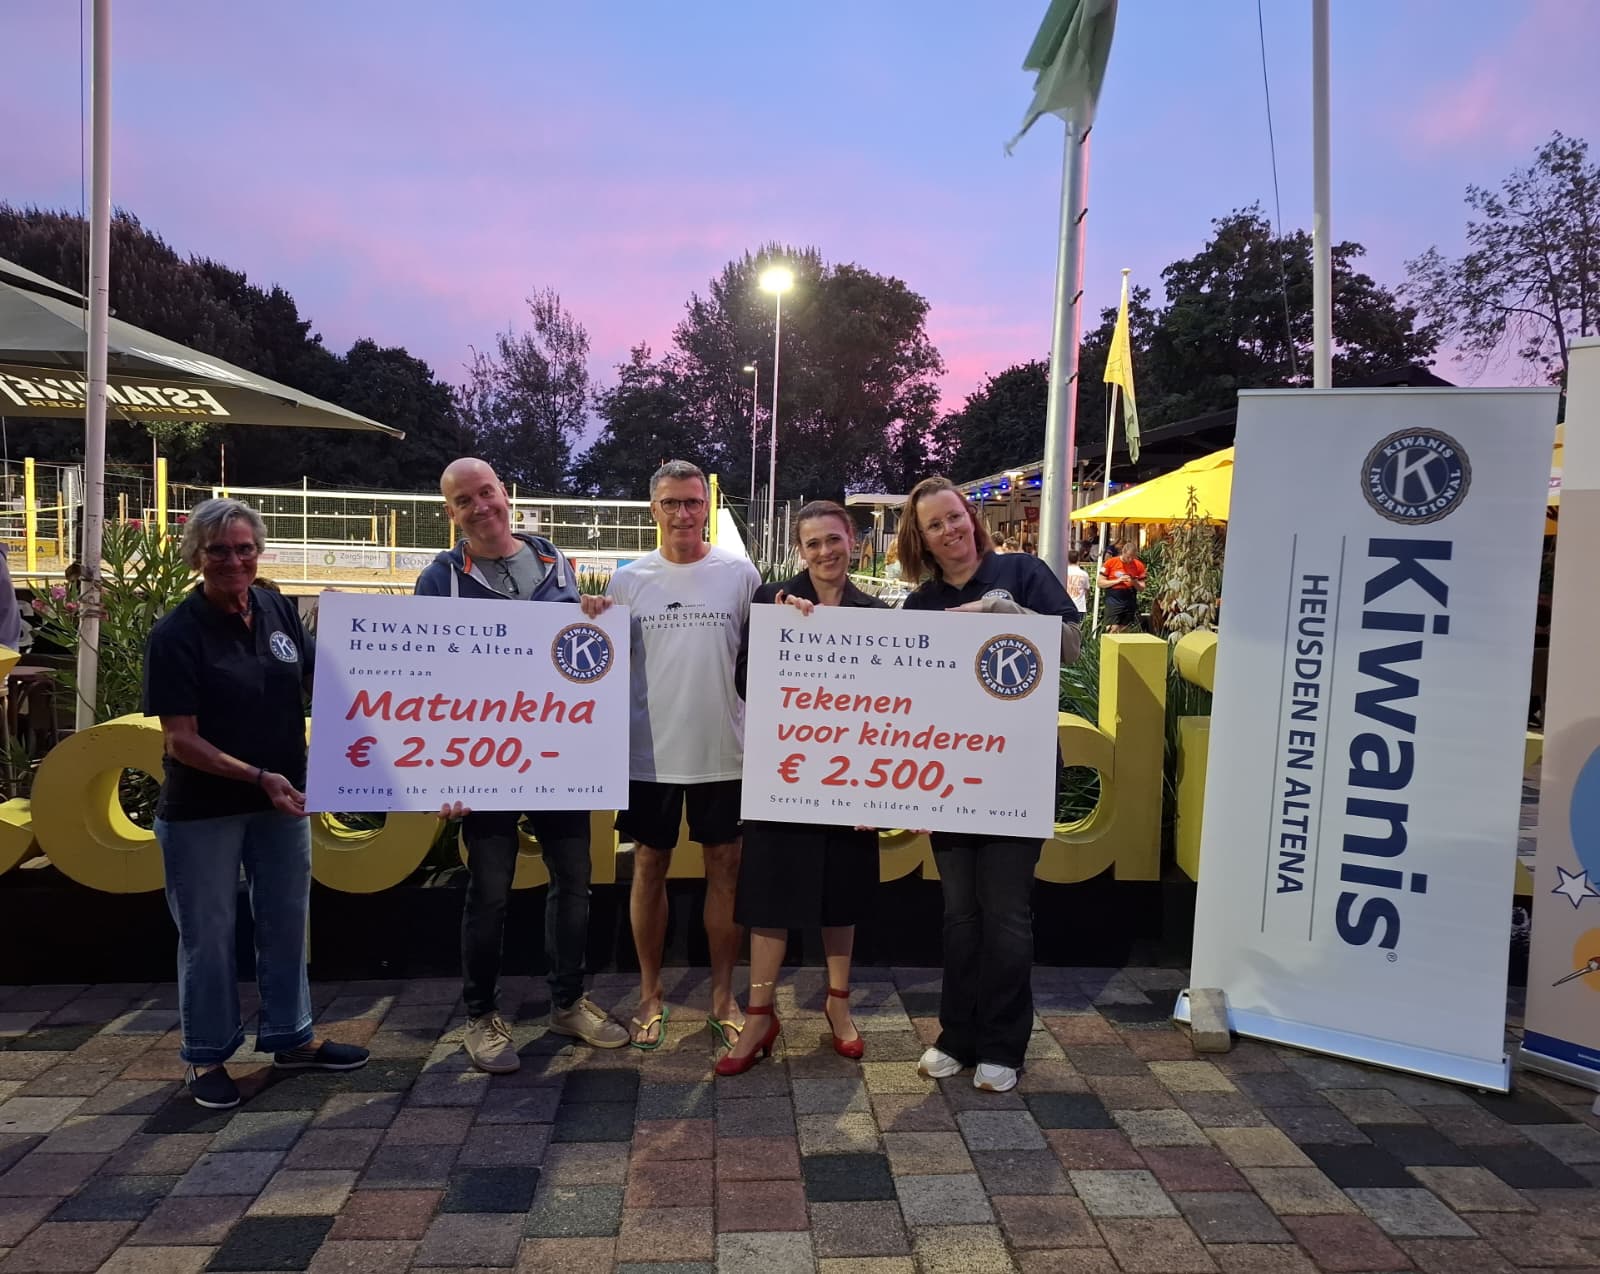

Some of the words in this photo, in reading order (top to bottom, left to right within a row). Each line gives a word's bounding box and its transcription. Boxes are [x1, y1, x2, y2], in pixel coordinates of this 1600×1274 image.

[1383, 436, 1454, 459] KIWANIS
[1370, 467, 1462, 517] INTERNATIONAL
[351, 618, 507, 637] KIWANISCLUB
[659, 613, 679, 621] DER
[682, 612, 732, 621] STRAATEN
[349, 639, 436, 653] Heusden
[447, 642, 460, 653] &
[471, 643, 535, 656] Altena
[563, 627, 603, 643] KIWANIS
[779, 628, 930, 649] KIWANISCLUB
[988, 639, 1032, 656] KIWANIS
[1290, 574, 1330, 721] HEUSDEN
[349, 667, 403, 677] doneert
[555, 647, 608, 680] INTERNATIONAL
[779, 650, 860, 665] Heusden
[870, 653, 882, 666] &
[893, 655, 958, 669] Altena
[779, 669, 828, 680] doneert
[835, 672, 856, 680] aan
[980, 659, 1037, 695] INTERNATIONAL
[345, 689, 596, 725] Matunkha
[780, 686, 912, 715] Tekenen
[777, 722, 849, 744] voor
[858, 722, 1006, 754] kinderen
[1286, 729, 1316, 771] EN
[1335, 537, 1455, 950] Kiwanis
[345, 736, 378, 768] €
[394, 736, 560, 774] 2.500,-
[777, 753, 806, 784] €
[820, 755, 983, 799] 2.500,-
[338, 785, 394, 797] Serving
[406, 785, 428, 794] the
[440, 785, 499, 794] children
[510, 785, 525, 794] of
[535, 785, 556, 794] the
[567, 785, 604, 794] world
[769, 794, 820, 807] Serving
[831, 798, 851, 807] the
[863, 799, 920, 811] children
[931, 803, 945, 812] of
[956, 806, 977, 815] the
[989, 807, 1027, 818] world
[1276, 777, 1312, 894] ALTENA
